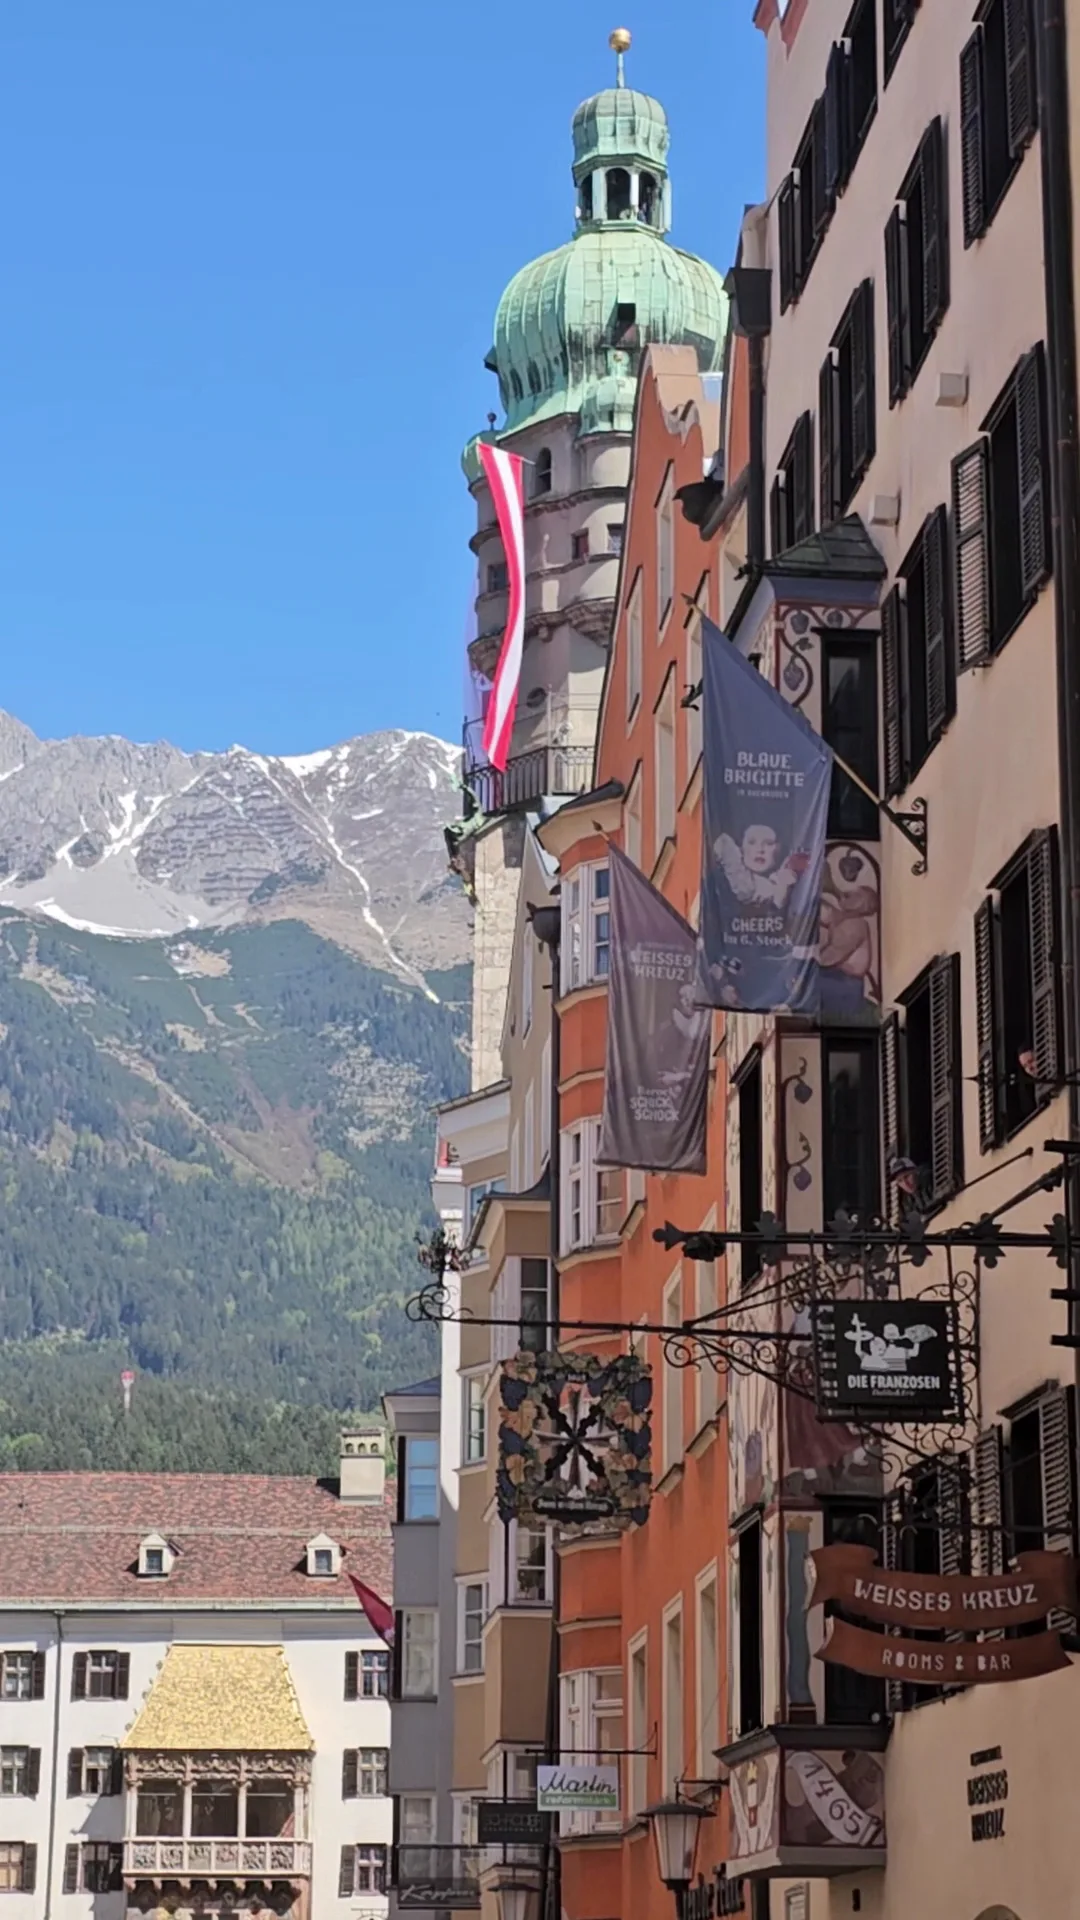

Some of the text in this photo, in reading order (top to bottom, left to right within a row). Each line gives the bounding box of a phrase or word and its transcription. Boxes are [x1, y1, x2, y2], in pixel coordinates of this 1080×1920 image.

[737, 751, 792, 769] BLAUE
[723, 767, 805, 787] BRIGITTE
[731, 916, 784, 933] CHEERS
[847, 1374, 941, 1390] DIE FRANZOSEN
[853, 1578, 1039, 1612] WEISSES KREUZ
[882, 1649, 945, 1671] ROOMS
[977, 1654, 1012, 1671] BAR
[539, 1771, 617, 1794] Martin
[803, 1763, 864, 1836] 1465
